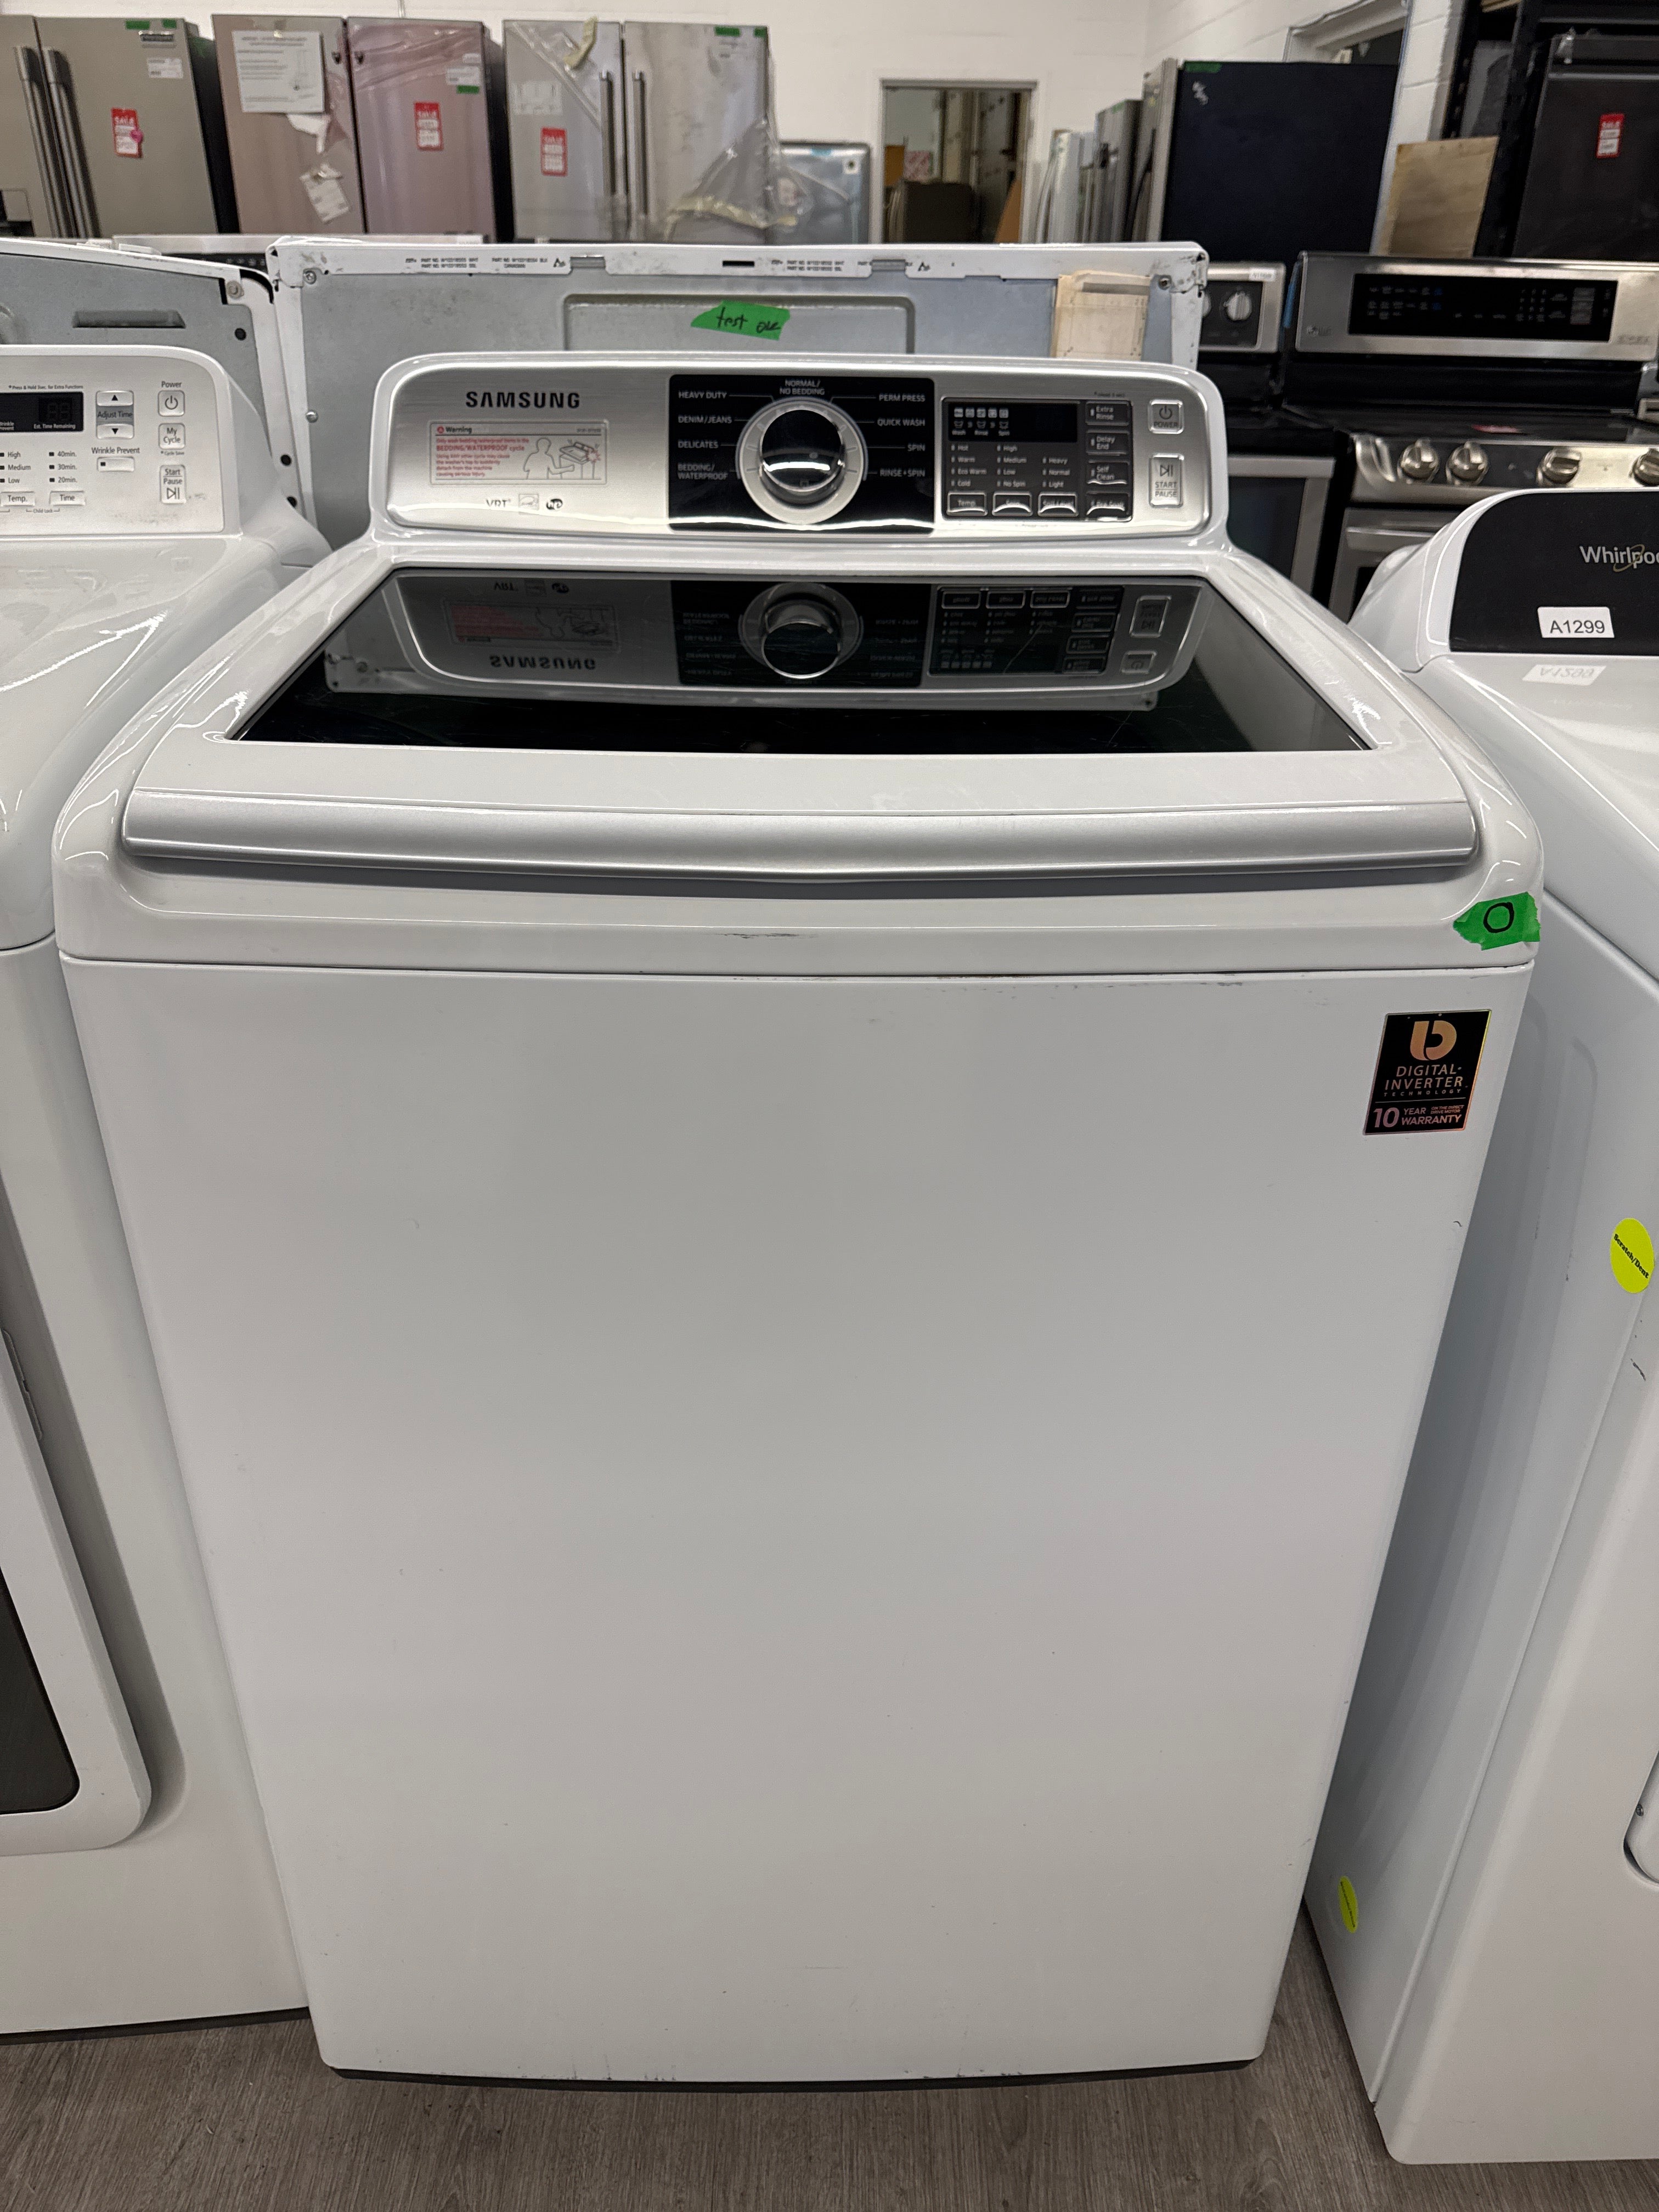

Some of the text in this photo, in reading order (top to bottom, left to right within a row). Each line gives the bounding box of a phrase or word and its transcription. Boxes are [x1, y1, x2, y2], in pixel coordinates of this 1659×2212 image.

[716, 307, 748, 330] test
[785, 379, 821, 388] NORMAL/
[678, 390, 727, 399] HEAVY DUTY
[878, 393, 926, 402] PERM PRESS
[465, 391, 580, 409] SAMSUNG
[678, 415, 732, 425] DENIM/JEANS
[877, 417, 901, 426] QUICK
[167, 427, 177, 436] My
[445, 426, 472, 435] Warning
[163, 436, 181, 444] Cycle
[678, 439, 719, 449] DELICATES
[907, 442, 926, 452] SPIN
[8, 452, 21, 460] High
[165, 468, 180, 476] Start
[678, 463, 715, 472] BEDDING/
[678, 472, 729, 480] WATERPROOF
[879, 469, 902, 477] RINSE
[907, 469, 926, 478] SPIN
[8, 495, 27, 504] Temp.
[1549, 619, 1606, 634] A1299
[1396, 1063, 1457, 1077] DIGITAL
[1385, 1076, 1464, 1091] INVERTER
[1384, 1088, 1462, 1097] TECHNOLOGY
[1403, 1107, 1426, 1115] YEAR
[1373, 1107, 1400, 1128] 10
[1401, 1114, 1462, 1126] WARRANTY
[1613, 1233, 1649, 1279] Scratch/Dent
